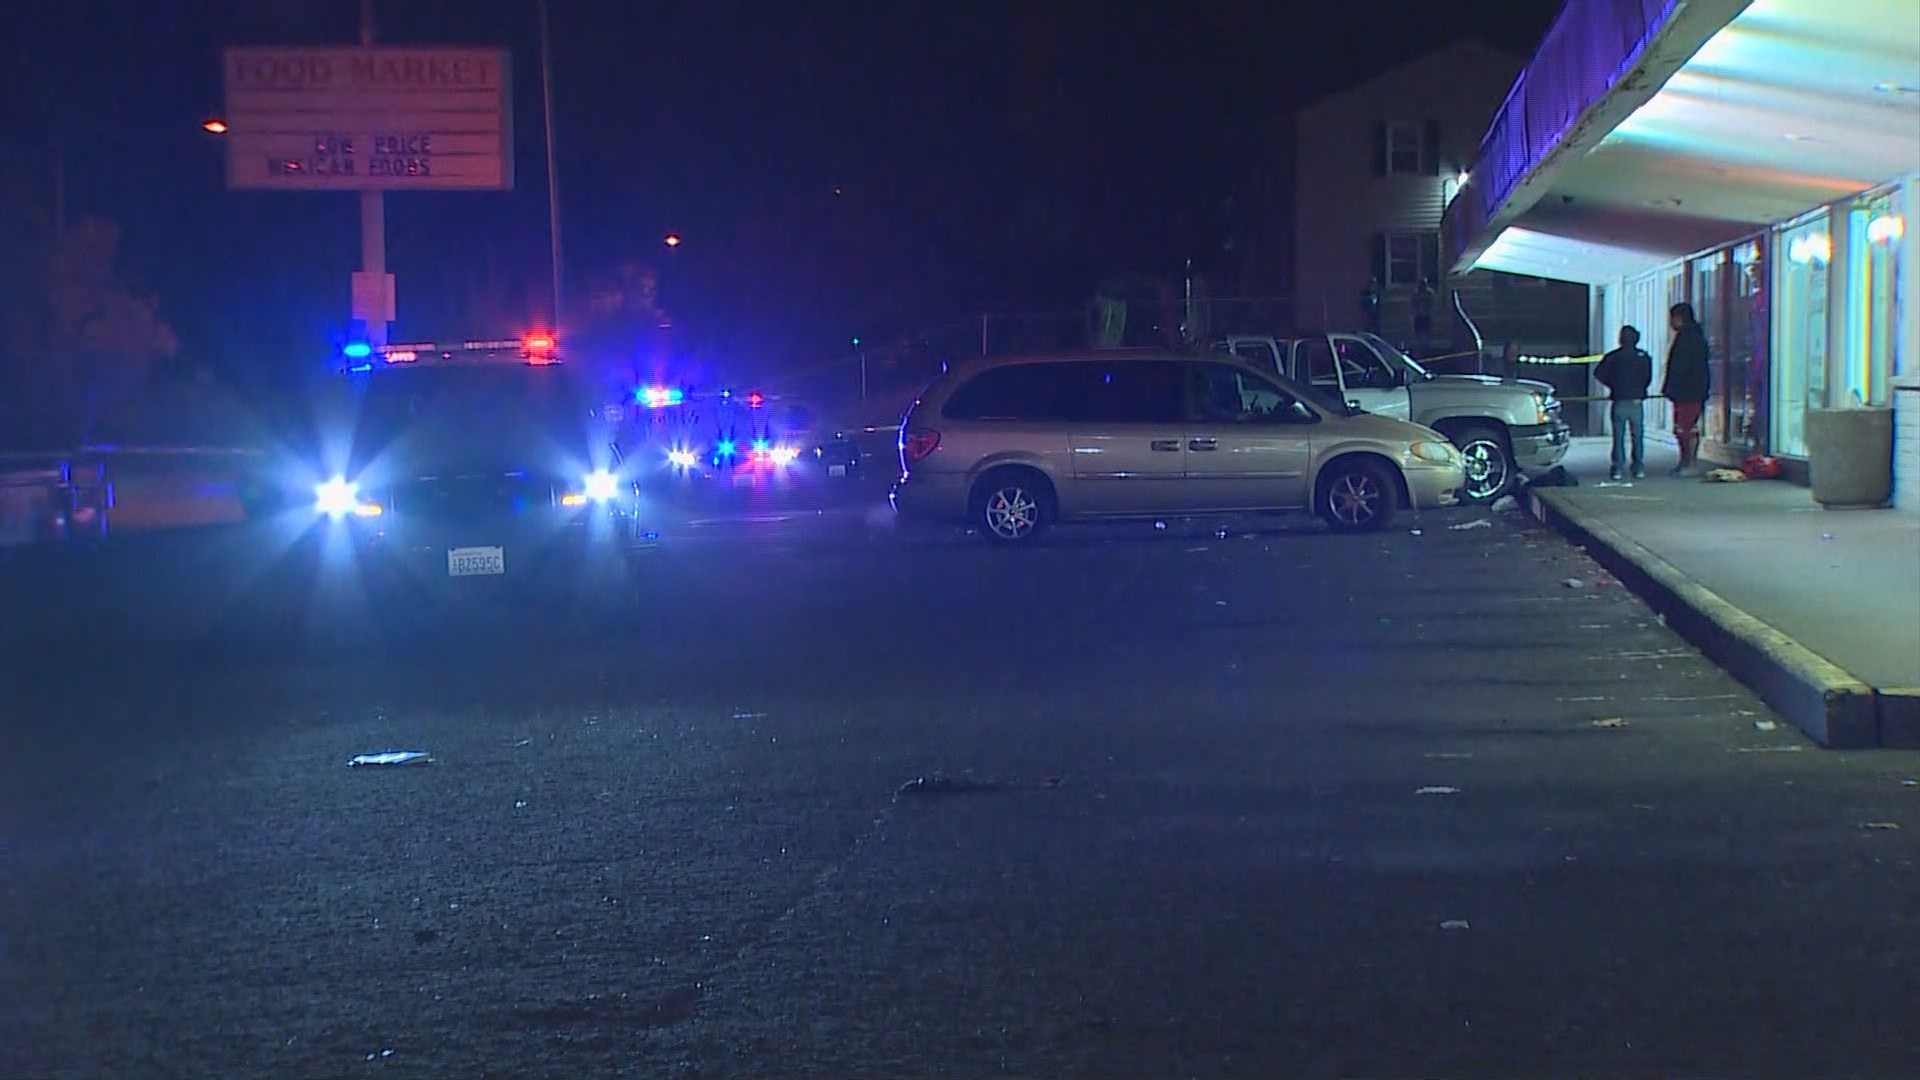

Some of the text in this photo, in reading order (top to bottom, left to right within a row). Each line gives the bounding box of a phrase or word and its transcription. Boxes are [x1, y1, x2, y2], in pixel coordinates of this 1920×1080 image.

[235, 55, 492, 84] FOOD MARKET
[315, 135, 431, 154] LOW PRICE
[370, 158, 431, 175] FOODS
